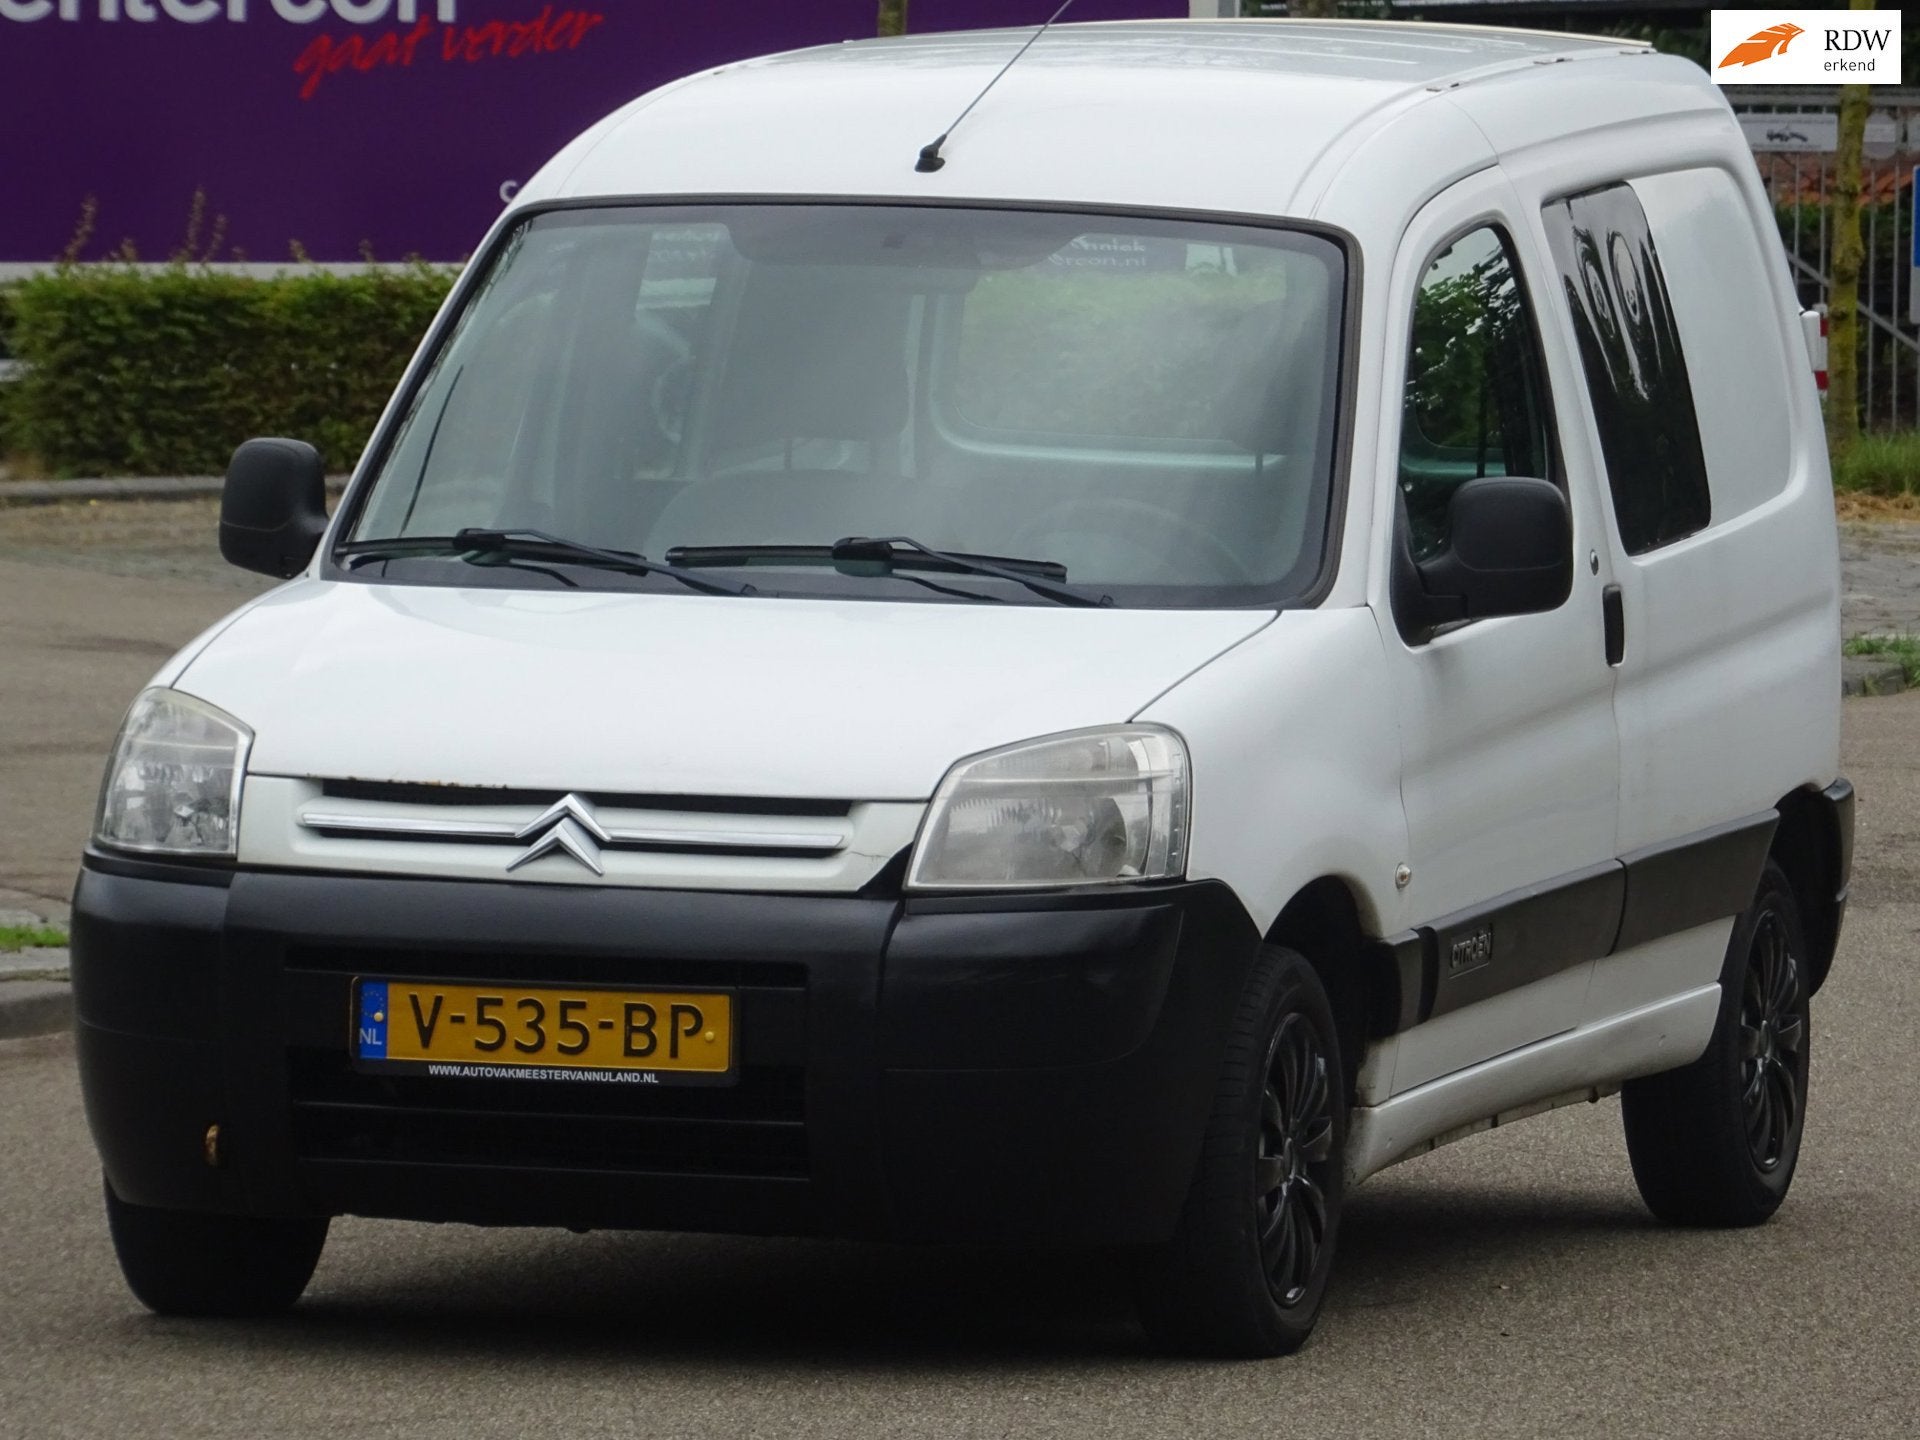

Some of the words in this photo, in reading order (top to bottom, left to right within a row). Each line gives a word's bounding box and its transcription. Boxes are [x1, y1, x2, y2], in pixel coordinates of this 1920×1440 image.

[292, 14, 433, 100] gaat
[442, 4, 604, 63] verder
[359, 1026, 383, 1046] NL
[408, 992, 704, 1060] V-535-BP
[428, 1064, 660, 1084] WWW.AUTOVAKMEESTERVANNULAND.NL
